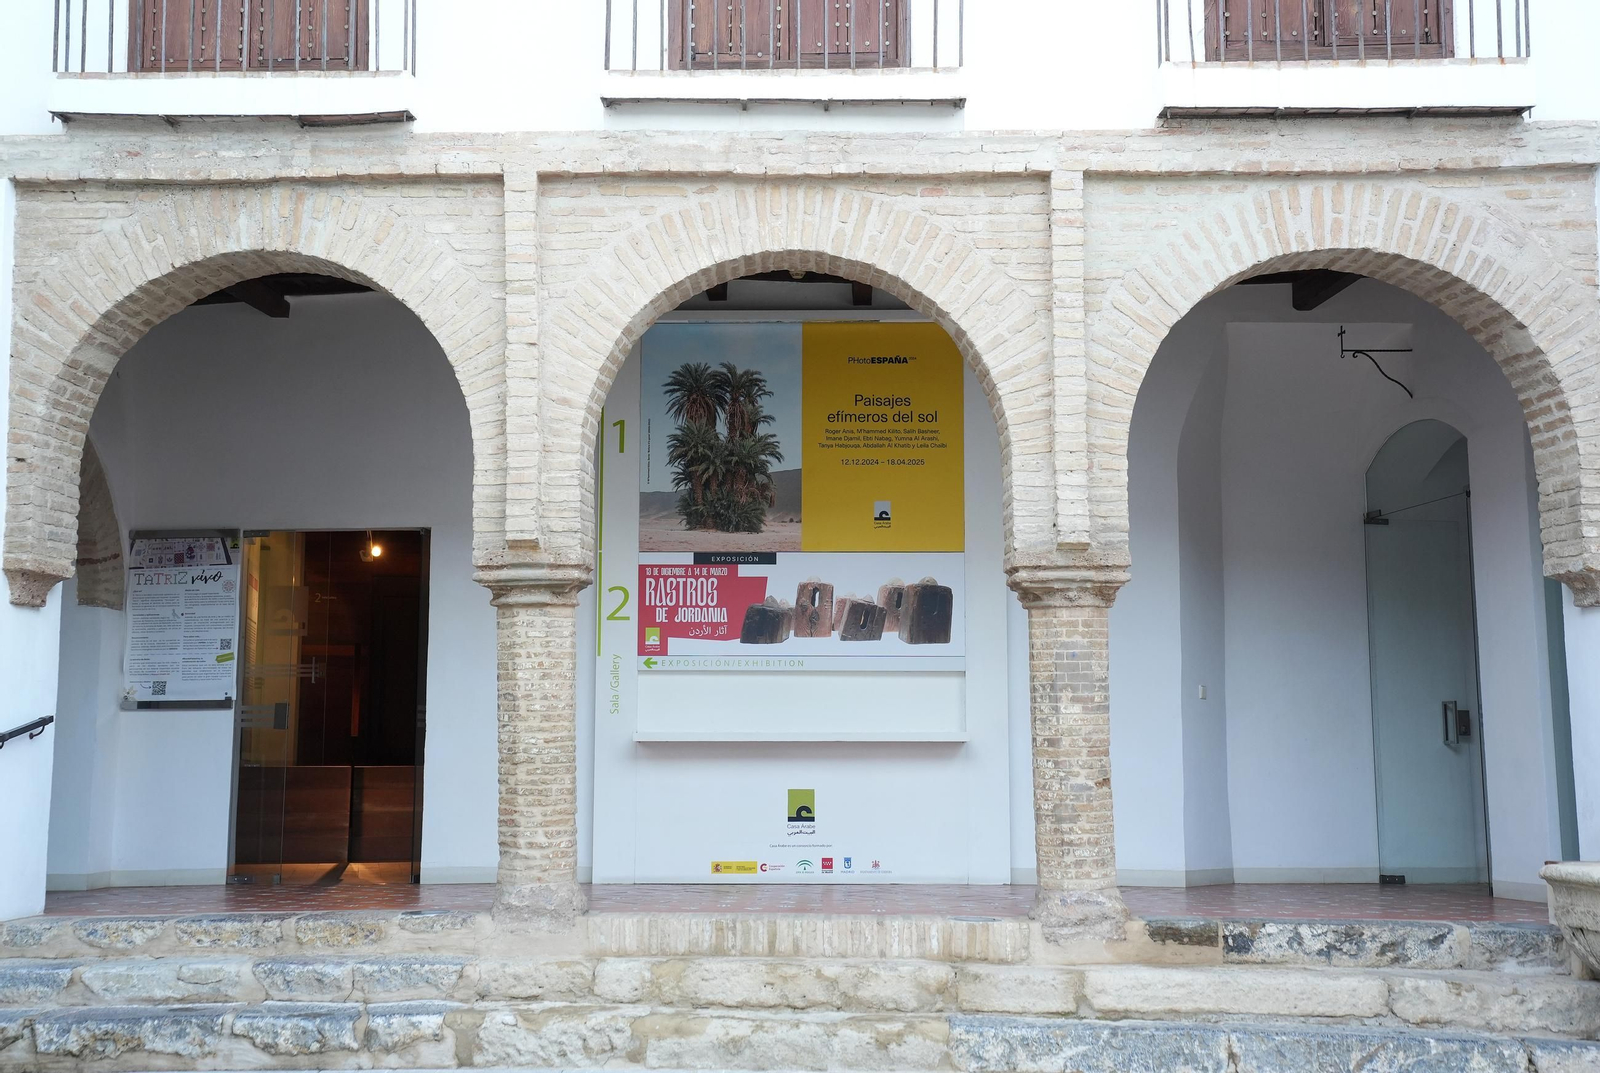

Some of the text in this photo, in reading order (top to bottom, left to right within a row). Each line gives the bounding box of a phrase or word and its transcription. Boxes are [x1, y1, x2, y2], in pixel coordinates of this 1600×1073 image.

[847, 355, 908, 364] PHotoESPAÑA
[854, 394, 912, 409] Paisajes
[827, 410, 938, 423] efímeros del sol
[612, 419, 626, 454] 1
[134, 571, 188, 586] TATRIZ
[653, 567, 659, 576] DE
[661, 567, 686, 576] DICIEMBRE
[688, 567, 692, 576] A
[694, 567, 700, 576] 14
[702, 567, 708, 576] DE
[710, 567, 728, 576] MARZO
[645, 577, 718, 607] RASTROS
[606, 585, 631, 621] 2
[656, 607, 728, 623] DE JORDANIA
[688, 624, 728, 637] آثار الأردن
[661, 658, 805, 667] EXPOSICIÓN/EXHIBITION
[609, 694, 620, 714] Sala
